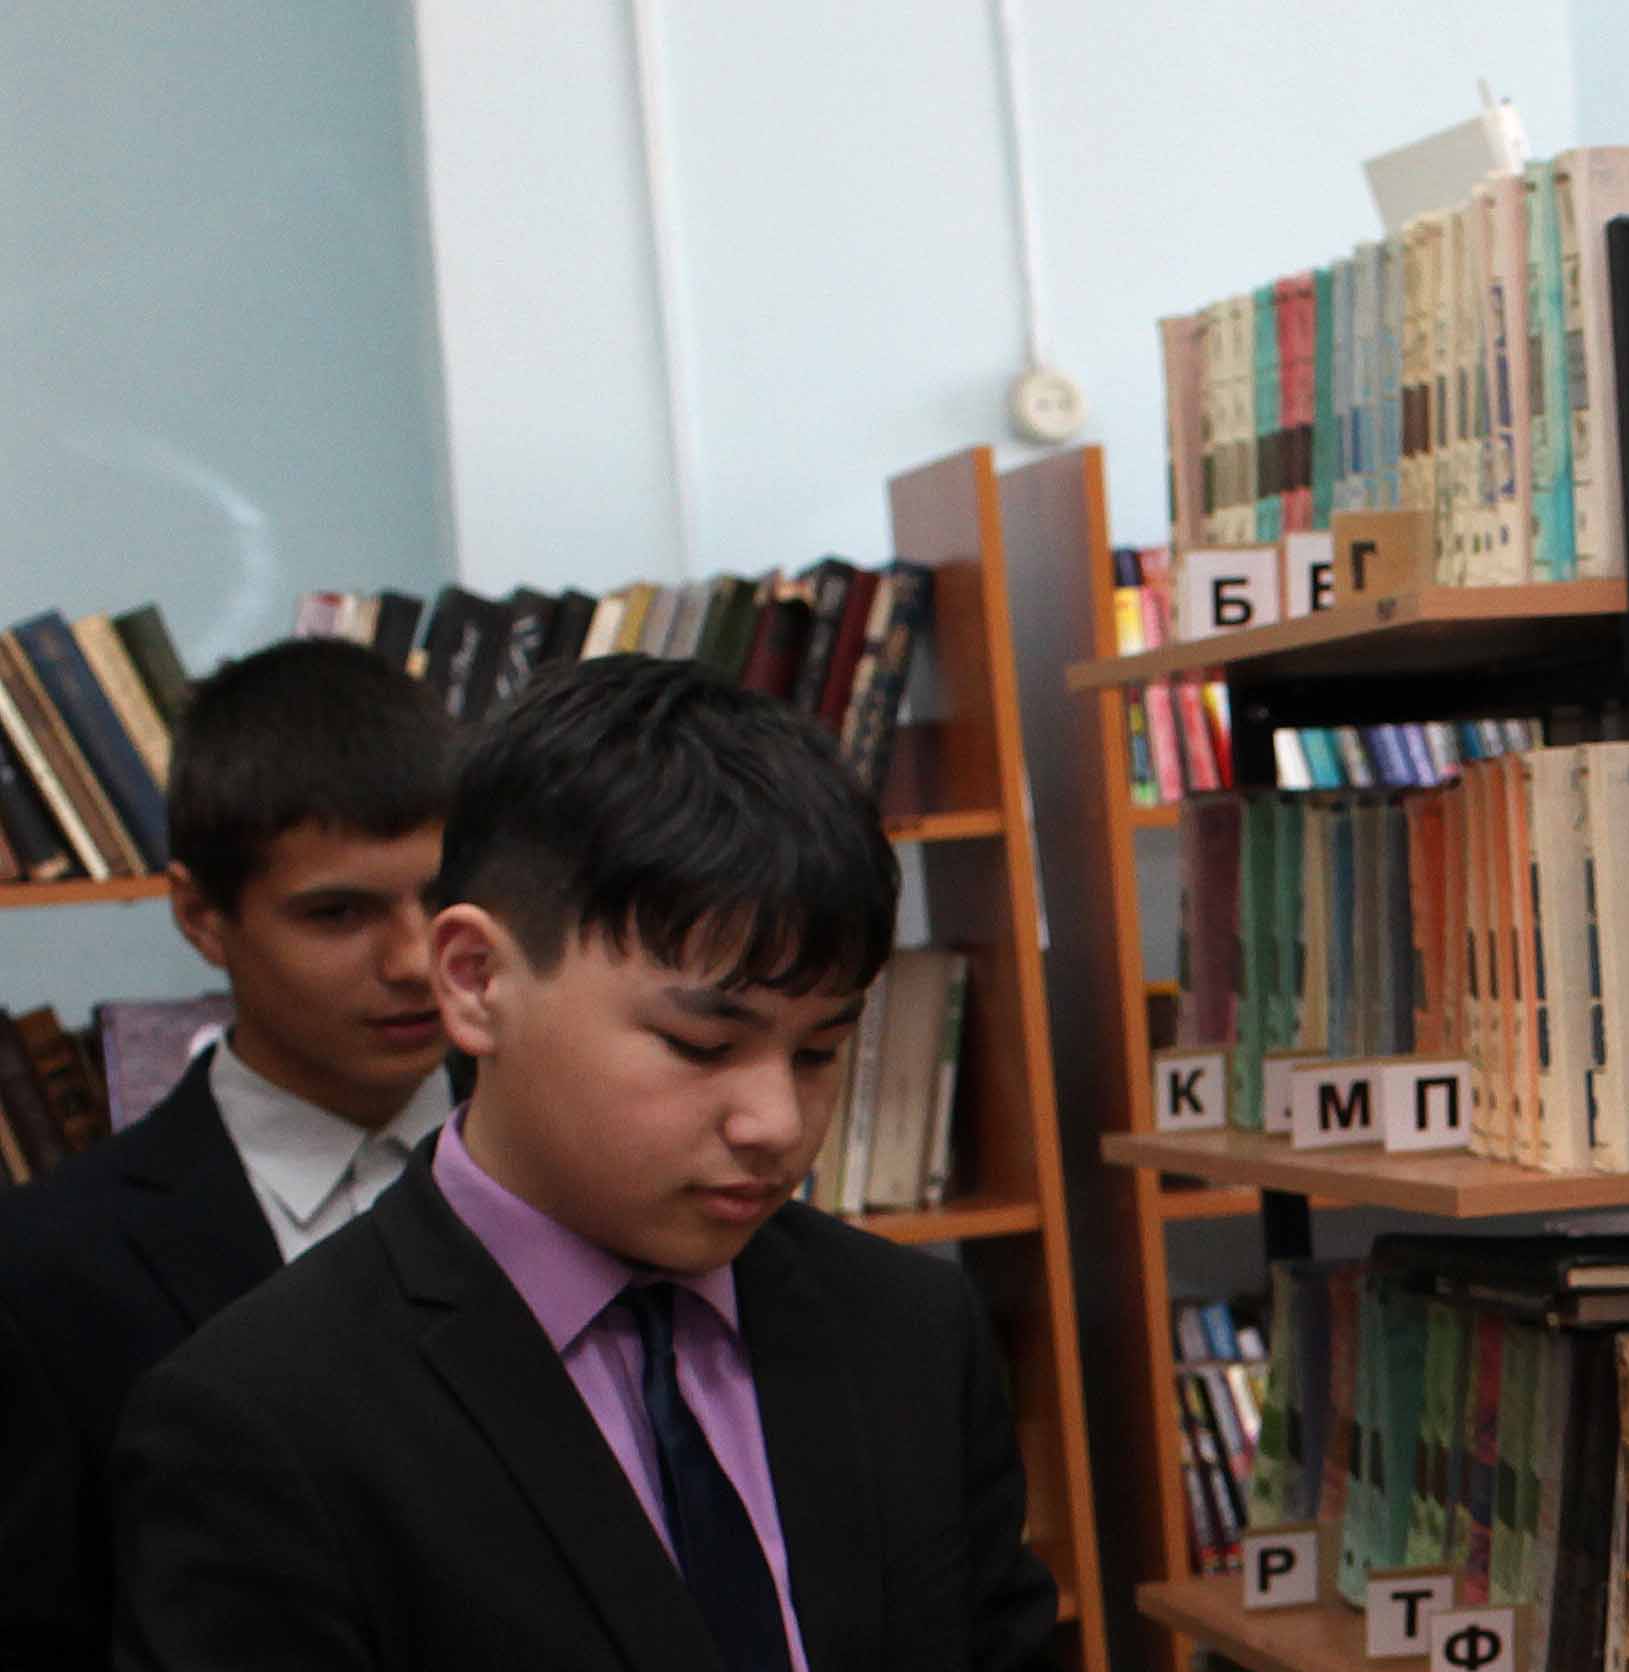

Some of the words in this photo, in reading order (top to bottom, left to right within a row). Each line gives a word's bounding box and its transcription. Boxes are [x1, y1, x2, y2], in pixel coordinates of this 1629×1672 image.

[1350, 540, 1377, 591] Г
[1212, 577, 1256, 627] Б
[1170, 1069, 1202, 1118] К
[1318, 1079, 1371, 1133] М
[1416, 1077, 1460, 1130] П
[1257, 1546, 1294, 1595] Р
[1391, 1589, 1434, 1639] Т
[1443, 1624, 1503, 1672] Ф
